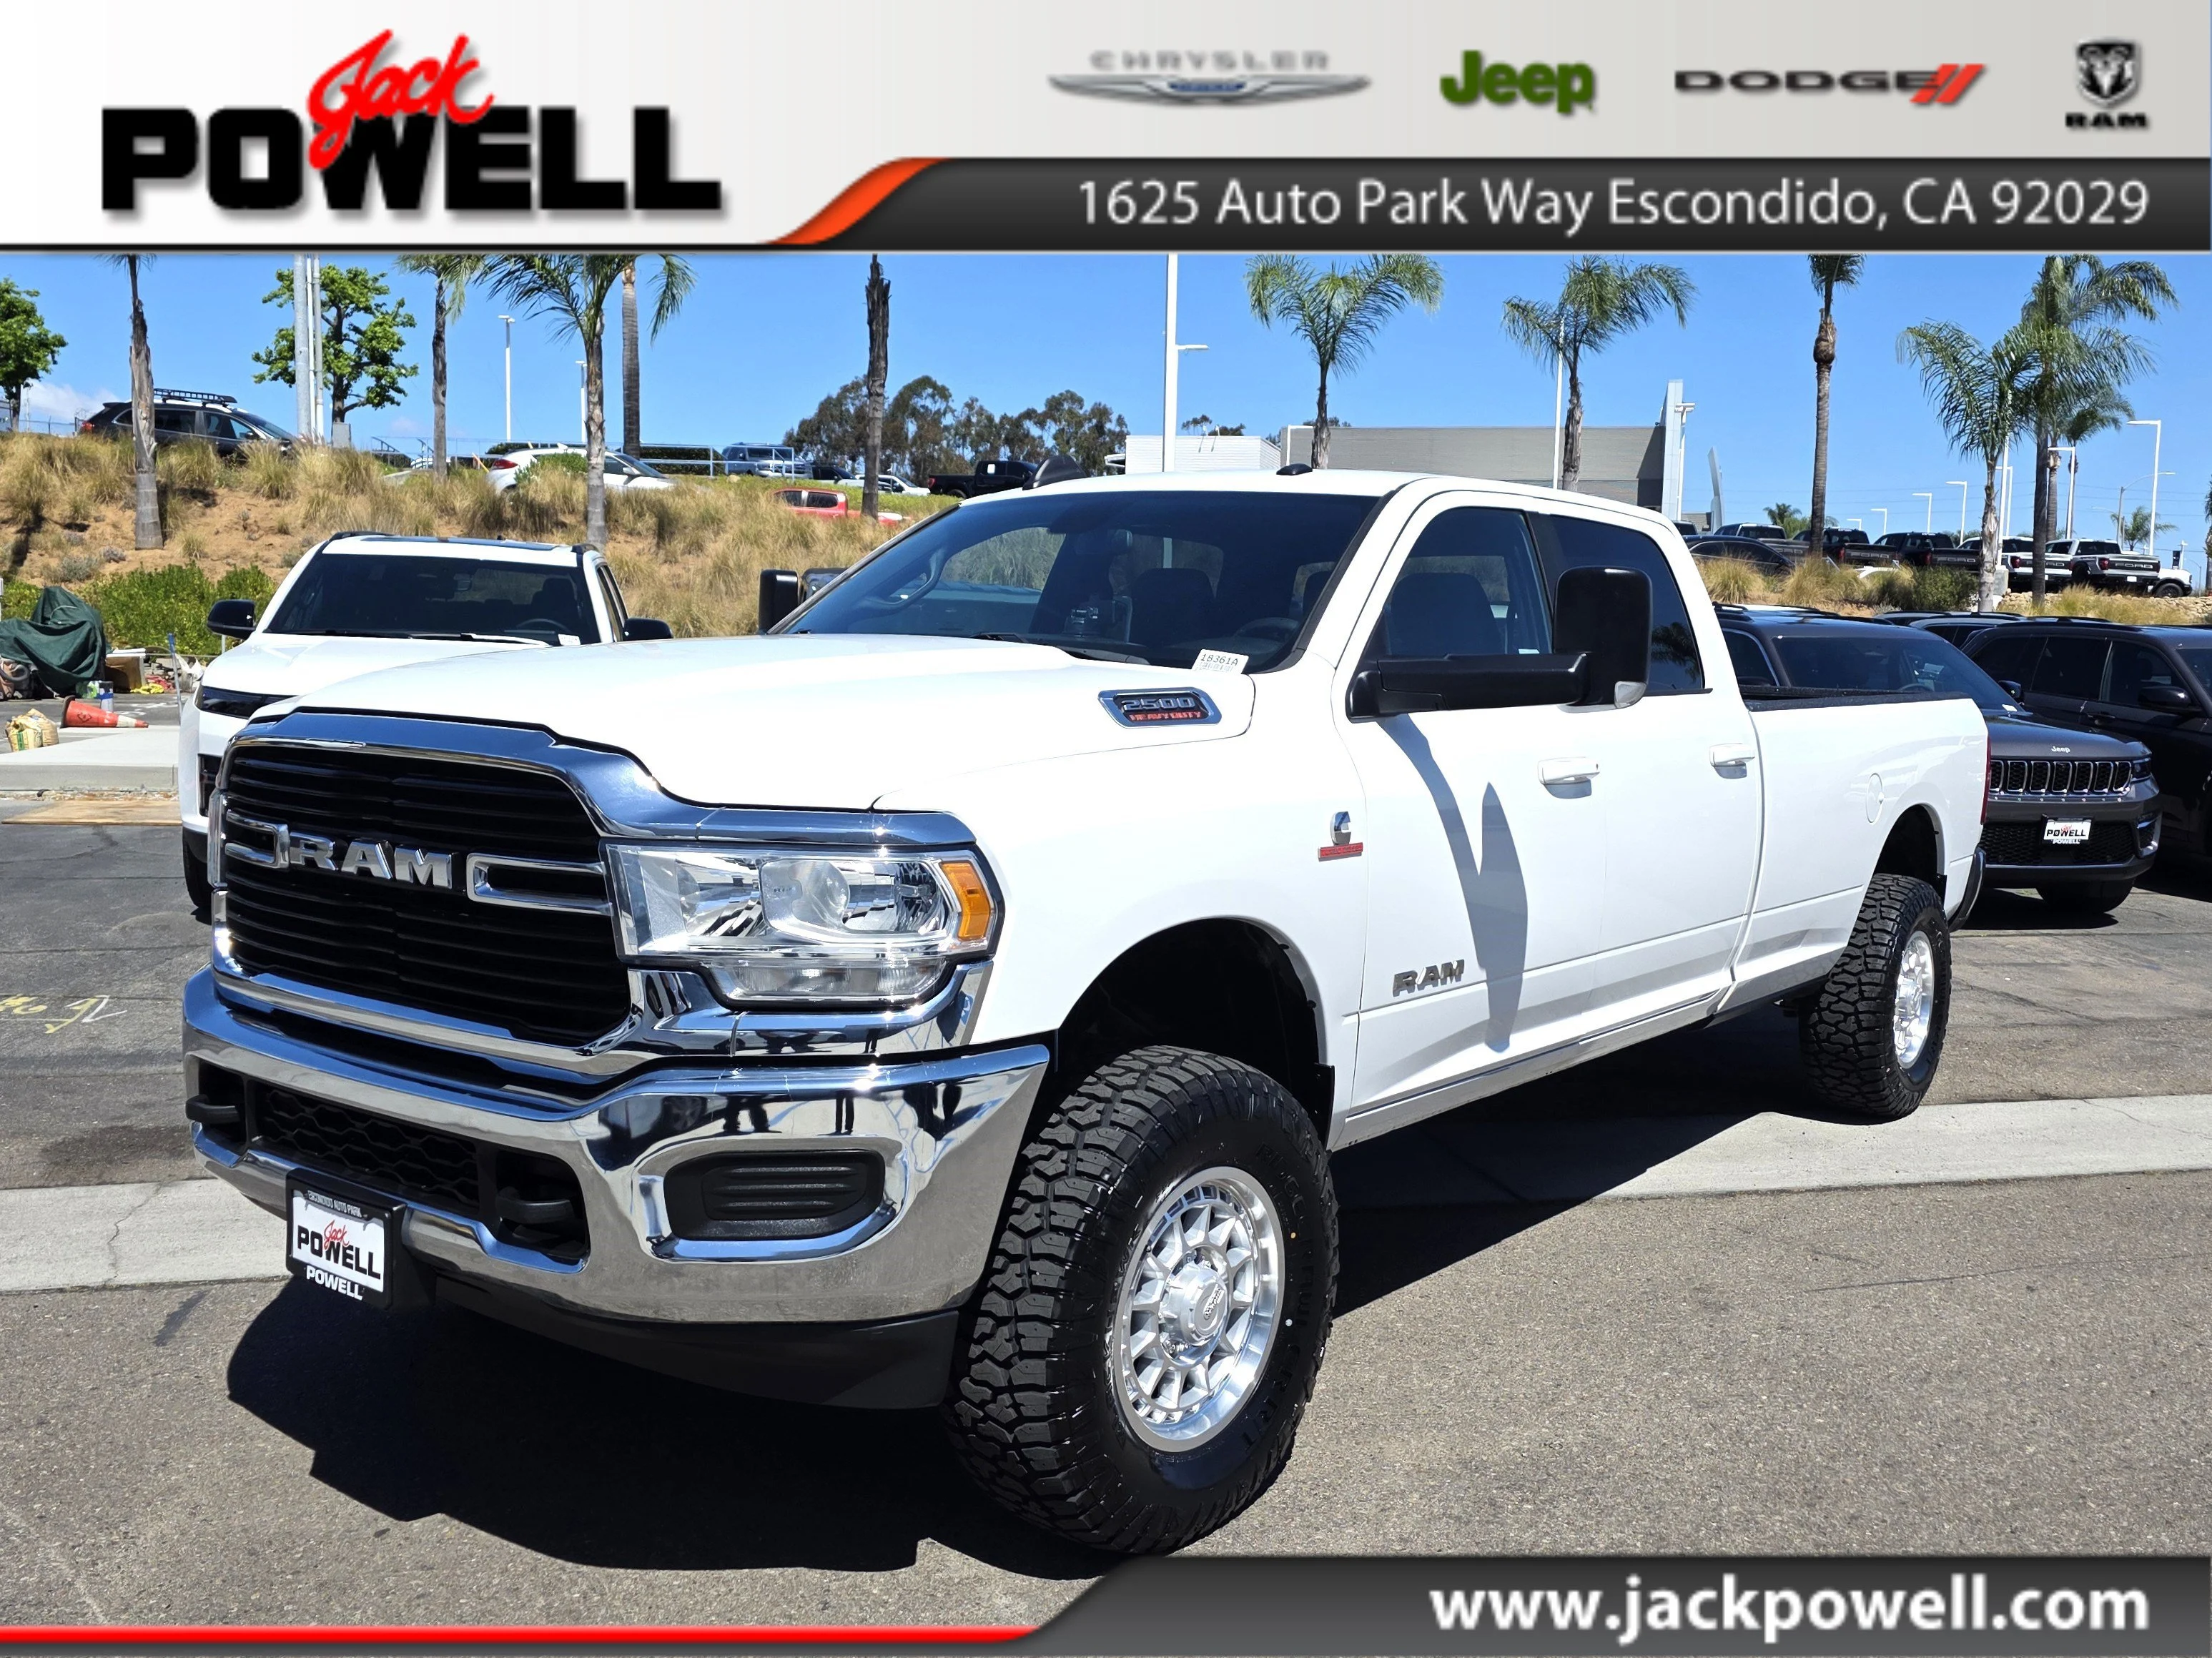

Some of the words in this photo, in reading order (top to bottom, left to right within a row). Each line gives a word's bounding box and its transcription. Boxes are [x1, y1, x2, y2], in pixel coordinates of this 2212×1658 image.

[1200, 653, 1239, 666] 18361A
[1121, 697, 1196, 711] 2500
[288, 831, 453, 890] RAM
[1392, 959, 1465, 992] RAM
[324, 1220, 350, 1250] Jack
[297, 1224, 381, 1280] POWELL
[306, 1265, 363, 1301] POWELL
